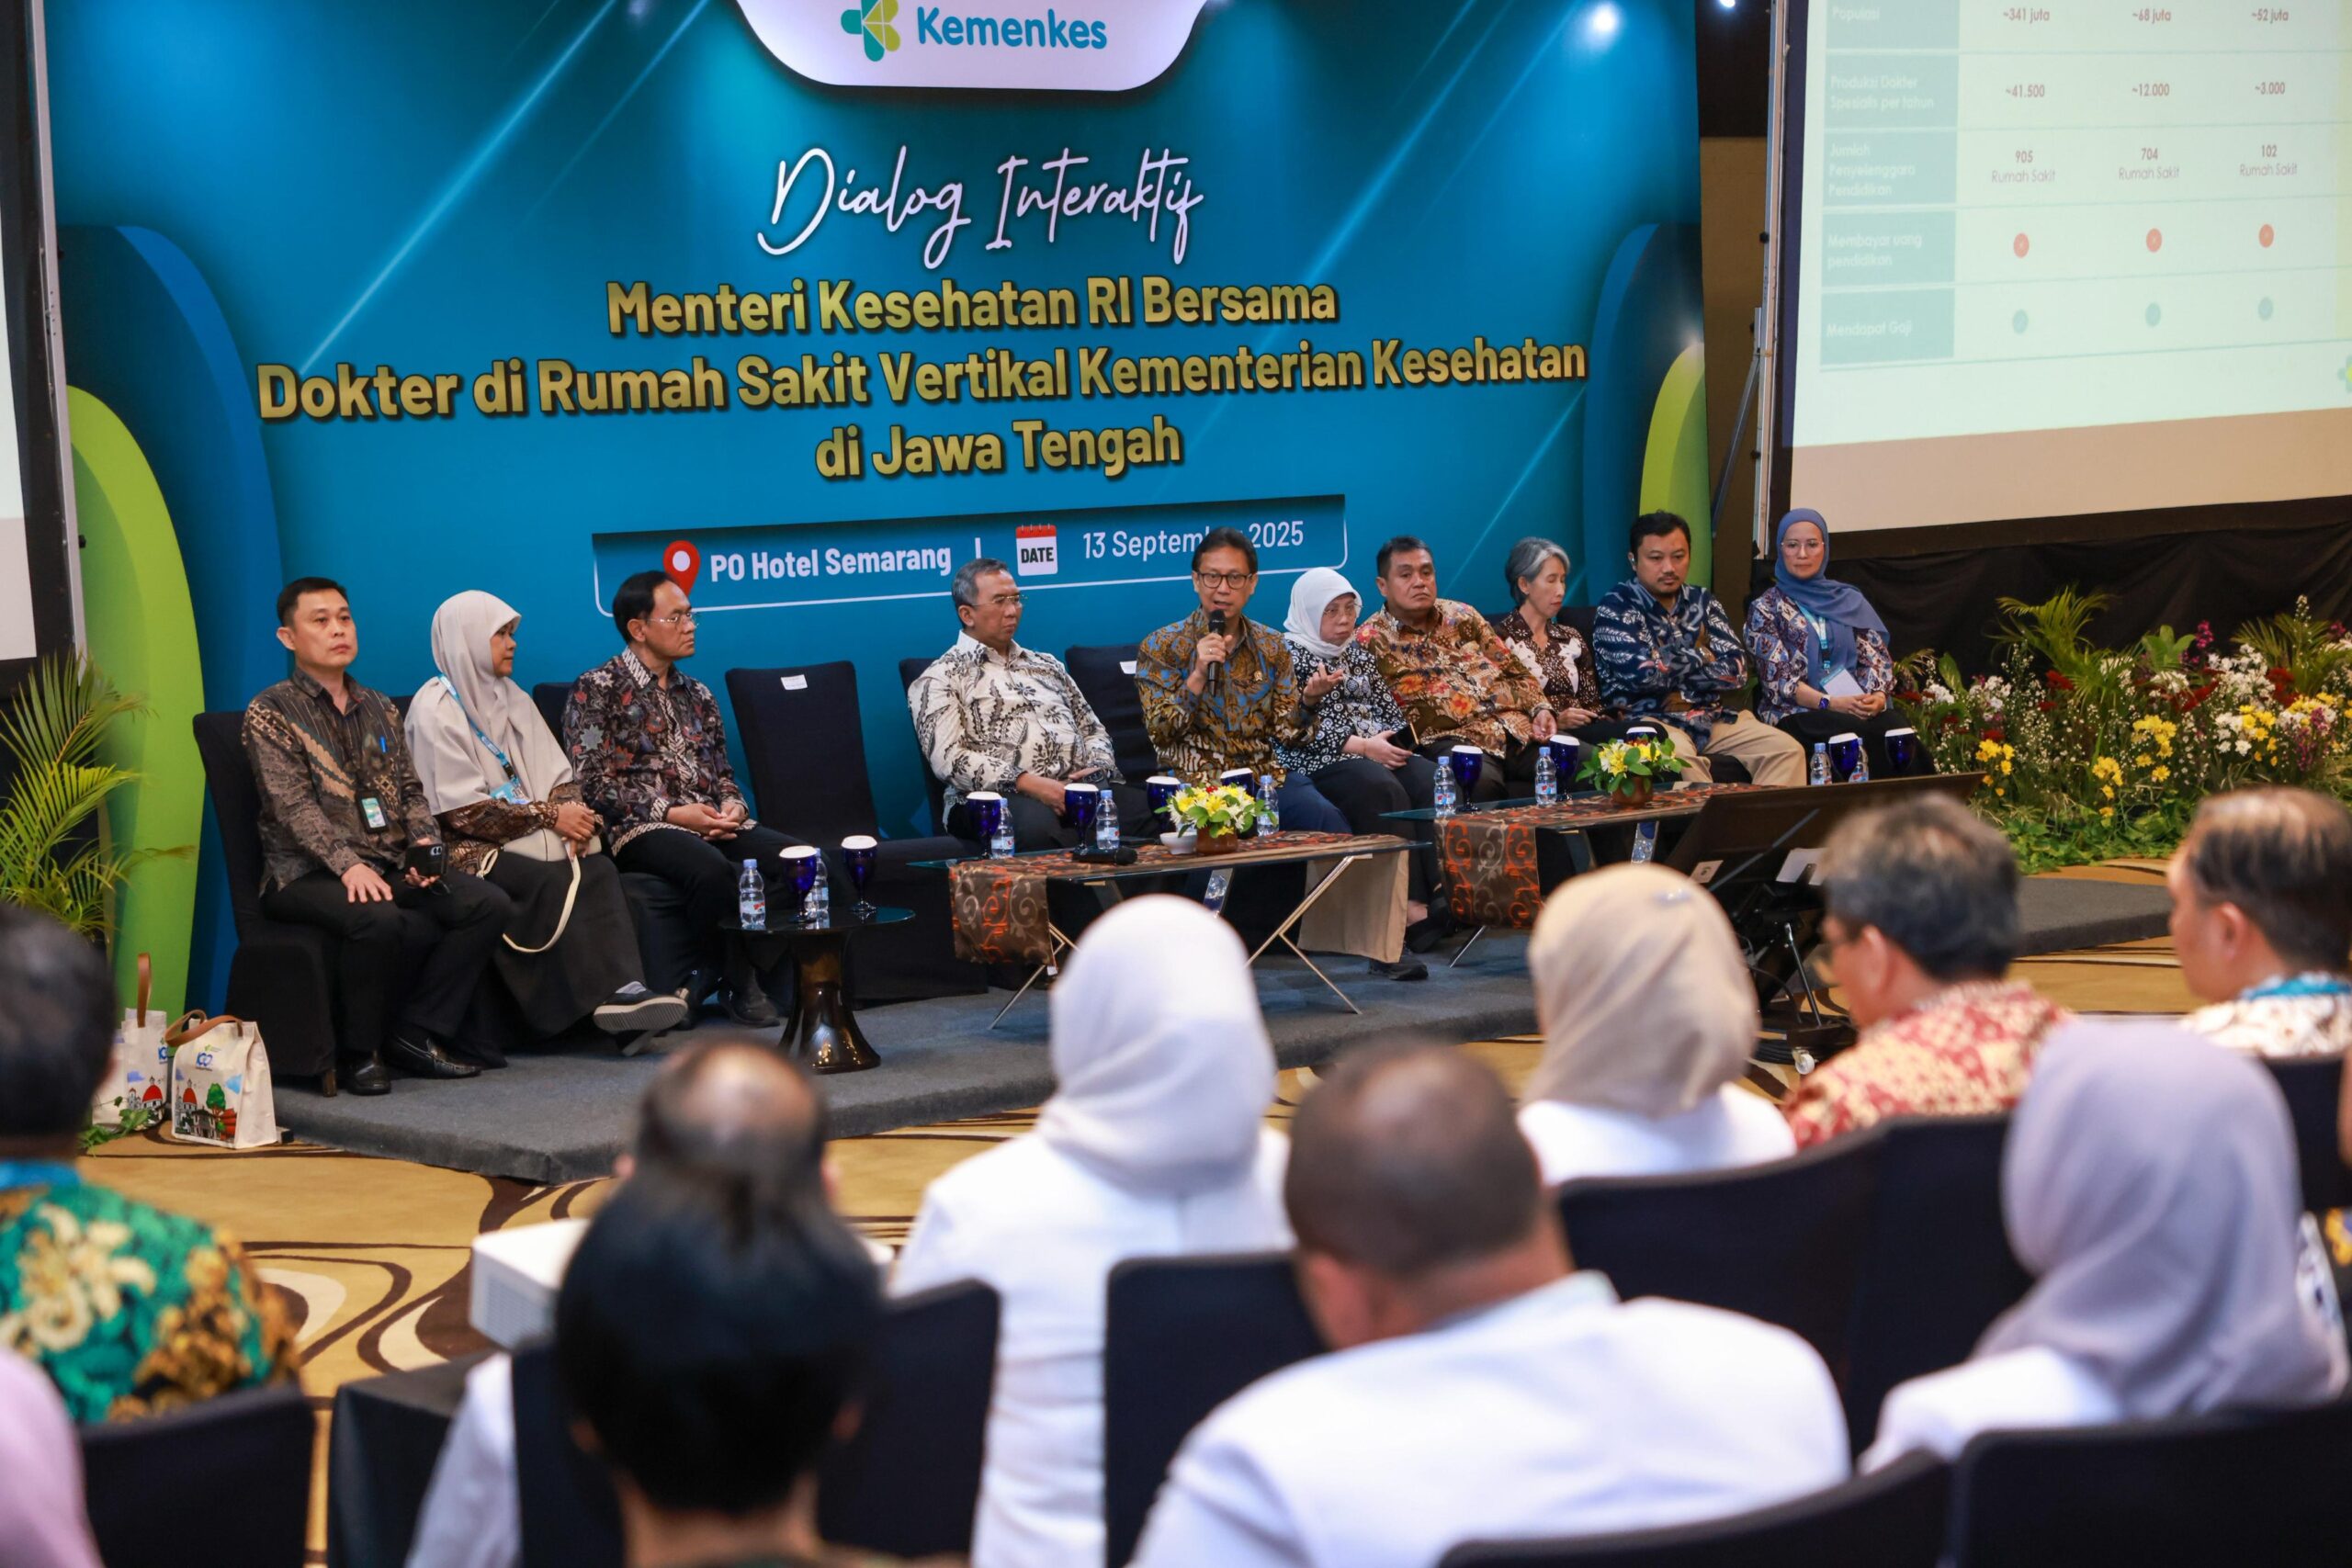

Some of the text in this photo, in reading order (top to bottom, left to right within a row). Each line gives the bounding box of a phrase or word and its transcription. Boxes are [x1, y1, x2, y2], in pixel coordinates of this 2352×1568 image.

[2030, 8, 2050, 24] juta
[2152, 9, 2171, 24] juta
[2269, 9, 2289, 24] juta
[918, 7, 1107, 50] Kemenkes
[1881, 97, 1899, 112] per
[1902, 96, 1934, 110] tahun
[1829, 141, 1871, 157] Jumlah
[2142, 148, 2158, 161] 704
[2261, 144, 2277, 157] 102
[2015, 151, 2033, 164] 905
[1992, 170, 2055, 183] Rumah Sakit
[2119, 166, 2179, 180] Rumah Sakit
[2240, 163, 2297, 177] Rumah Sakit
[757, 145, 1204, 269] Dialog Interaktif
[1827, 233, 1923, 250] Membayar uang
[1827, 253, 1893, 270] pendidikan
[606, 277, 1338, 334] Menteri Kesehatan RI Bersama
[1888, 320, 1912, 337] Gaji
[257, 337, 1586, 419] Dokter di Rumah Sakit Vertikal Kementerian Kesehatan
[815, 415, 1182, 478] di Jawa Tengah
[1083, 521, 1304, 562] 13 Septem 2025
[1021, 547, 1054, 564] DATE
[710, 547, 951, 582] PO Hotel Semarang
